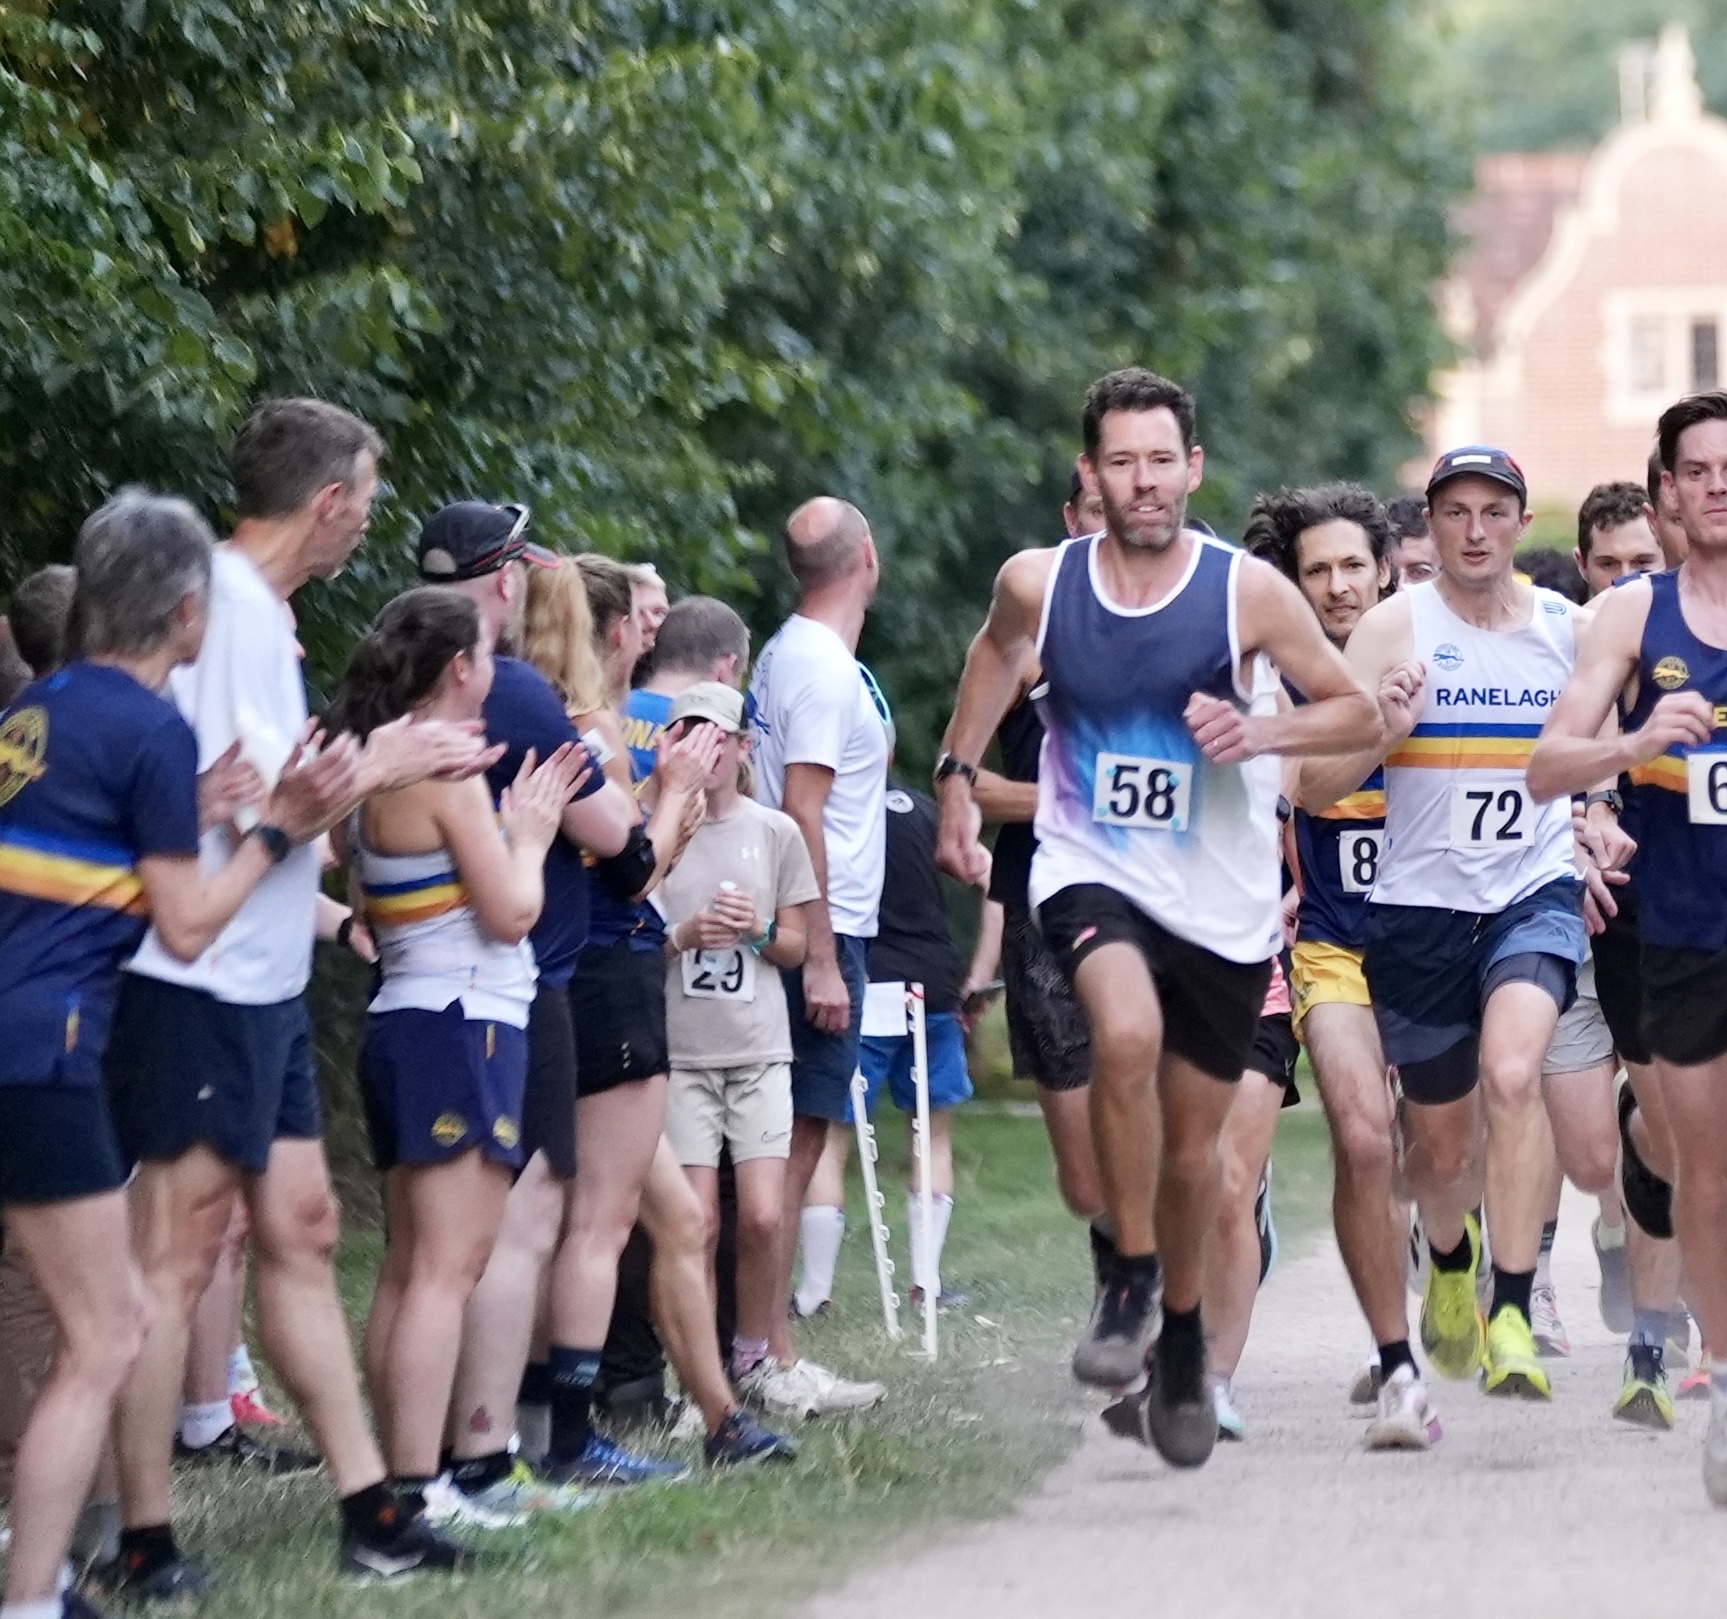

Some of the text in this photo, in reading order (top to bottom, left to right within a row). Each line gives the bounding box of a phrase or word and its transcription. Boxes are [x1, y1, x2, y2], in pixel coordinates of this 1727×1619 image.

[1109, 764, 1177, 821] 58
[1466, 789, 1523, 841] 72
[1352, 836, 1379, 886] 8
